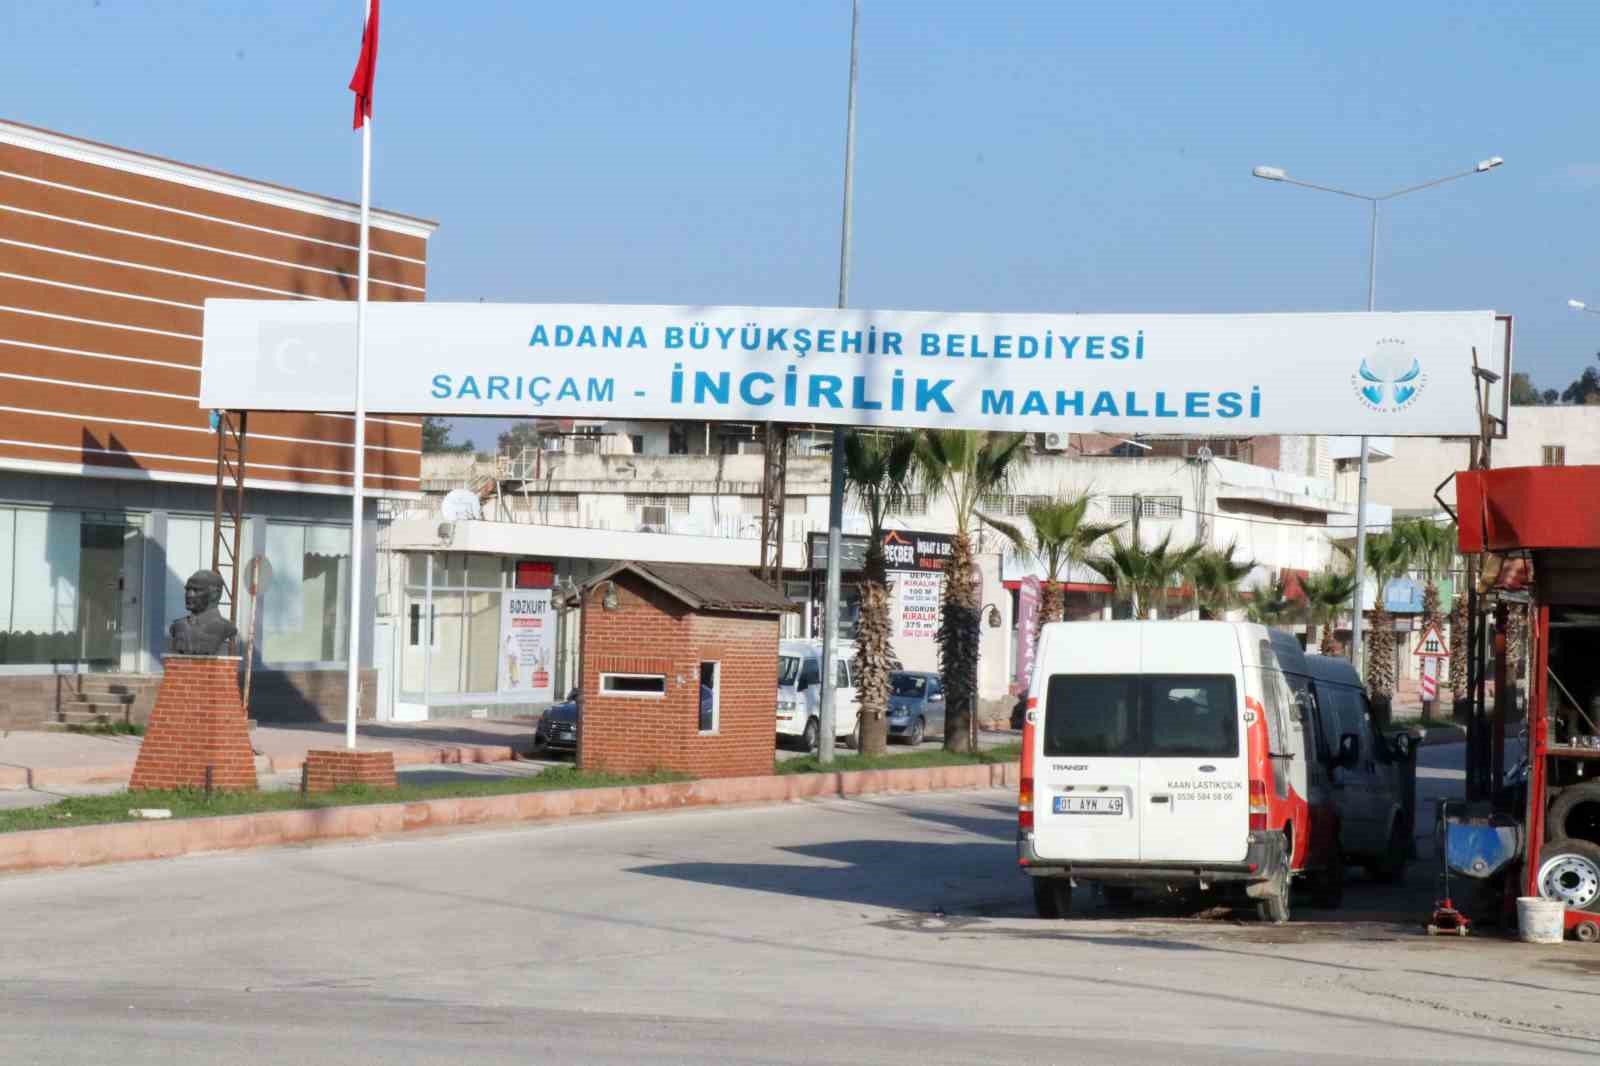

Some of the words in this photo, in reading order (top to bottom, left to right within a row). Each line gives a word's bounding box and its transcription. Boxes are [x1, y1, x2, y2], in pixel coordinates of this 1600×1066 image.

[528, 323, 648, 349] ADANA
[664, 323, 903, 358] BÜYÜKŞEHİR
[919, 330, 1145, 361] BELEDİYESİ
[431, 374, 615, 407] SARIÇAM
[671, 362, 954, 415] İNCİRLİK
[980, 388, 1262, 418] MAHALLESİ
[1167, 780, 1191, 789] KAAN
[1061, 799, 1072, 810] 01
[1108, 799, 1121, 811] 49
